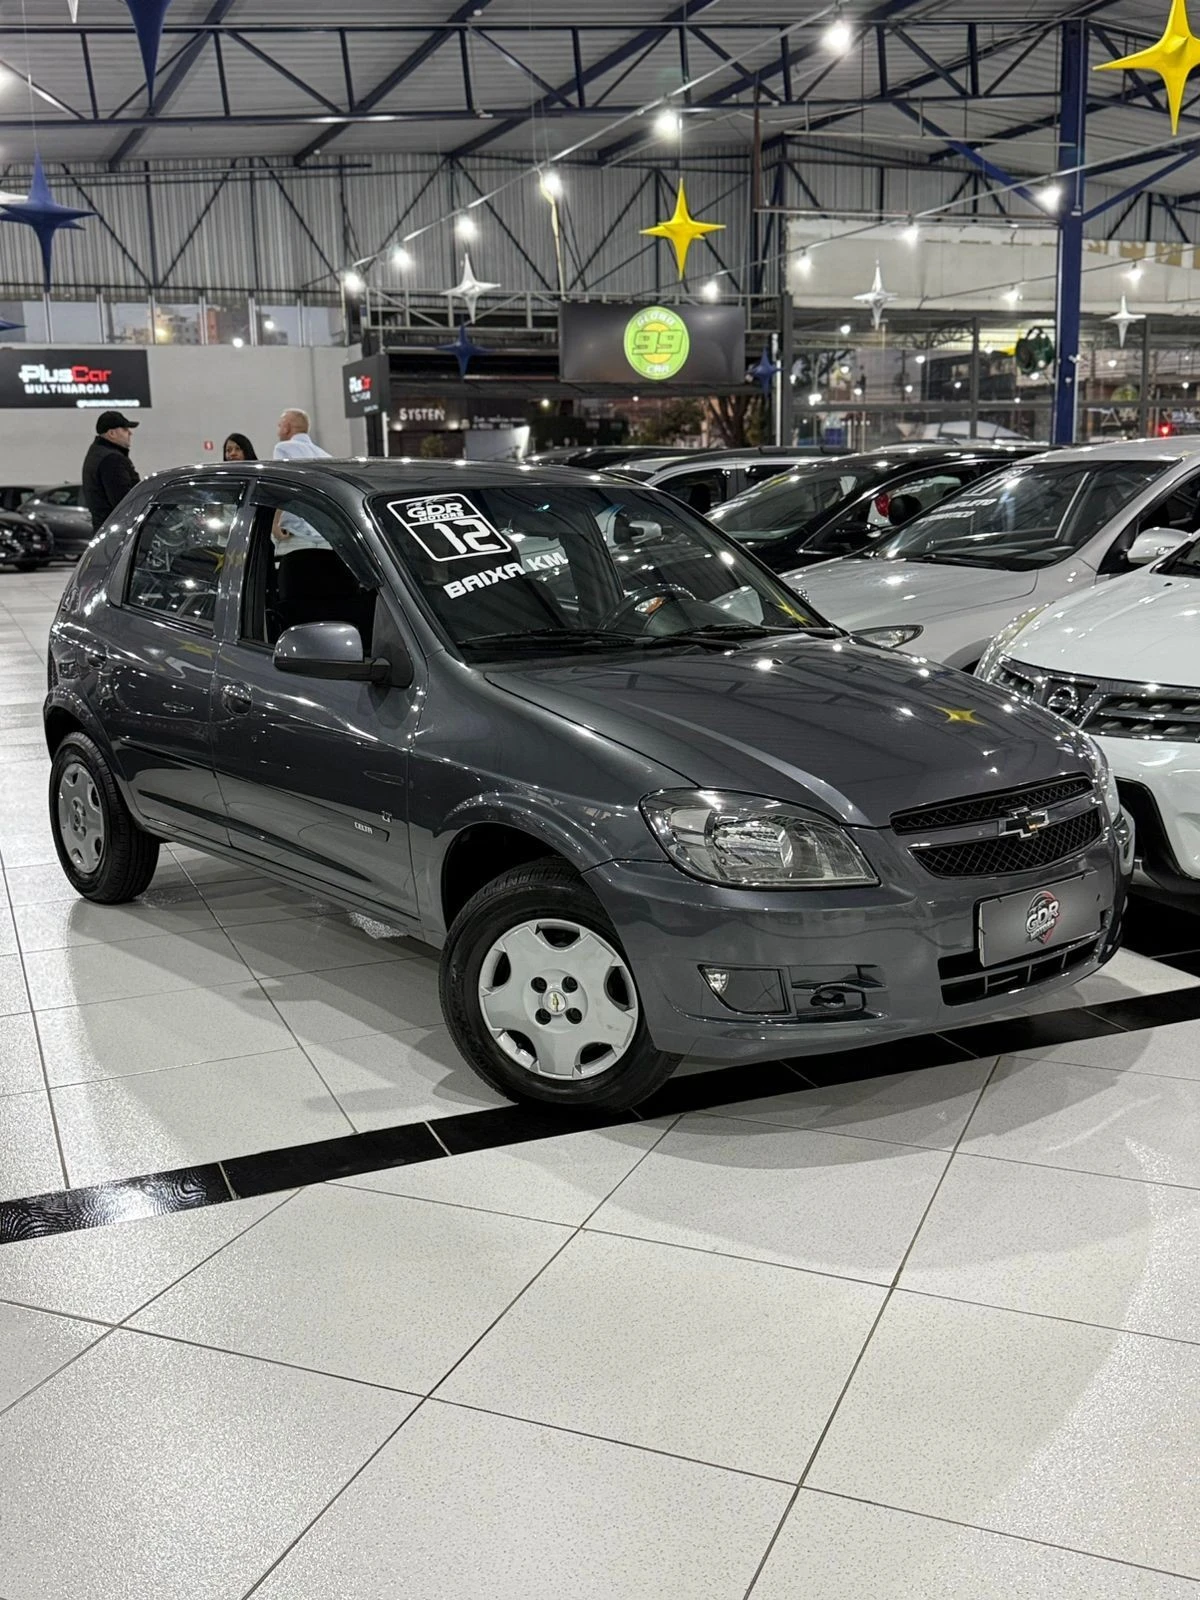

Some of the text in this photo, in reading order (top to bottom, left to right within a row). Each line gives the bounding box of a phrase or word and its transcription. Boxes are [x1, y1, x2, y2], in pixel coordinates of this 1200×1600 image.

[632, 329, 684, 355] 99
[24, 384, 110, 394] MULTIMARCAS
[407, 502, 464, 518] GDR
[419, 511, 465, 522] MOTORS
[433, 518, 502, 554] 12
[443, 552, 568, 599] BAIXA KM
[1026, 900, 1060, 933] GDR
